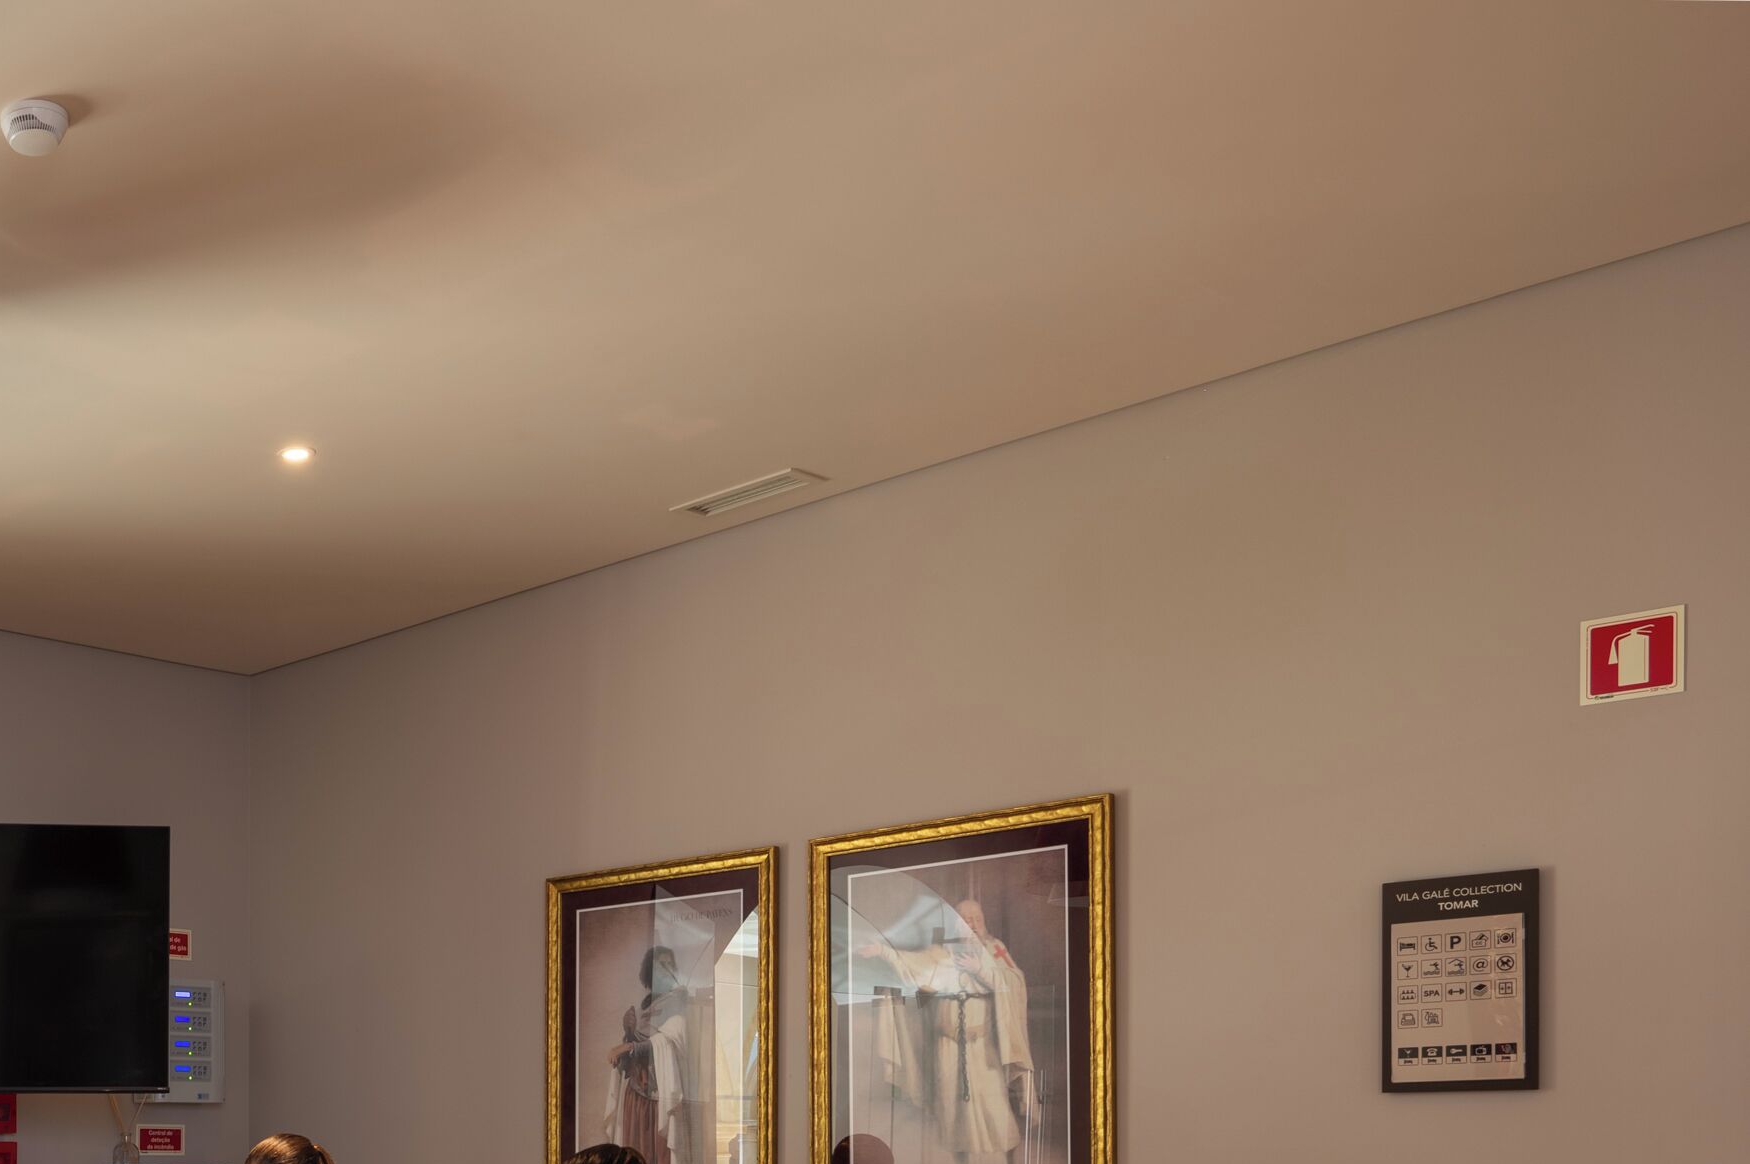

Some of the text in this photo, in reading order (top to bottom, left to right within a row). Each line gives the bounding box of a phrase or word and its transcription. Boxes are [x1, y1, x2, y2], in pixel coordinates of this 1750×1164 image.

[1396, 883, 1523, 902] VILA GALÉ COLLECTION
[1438, 900, 1479, 911] TOMAR
[1450, 935, 1462, 949] P
[1423, 989, 1440, 998] SPA
